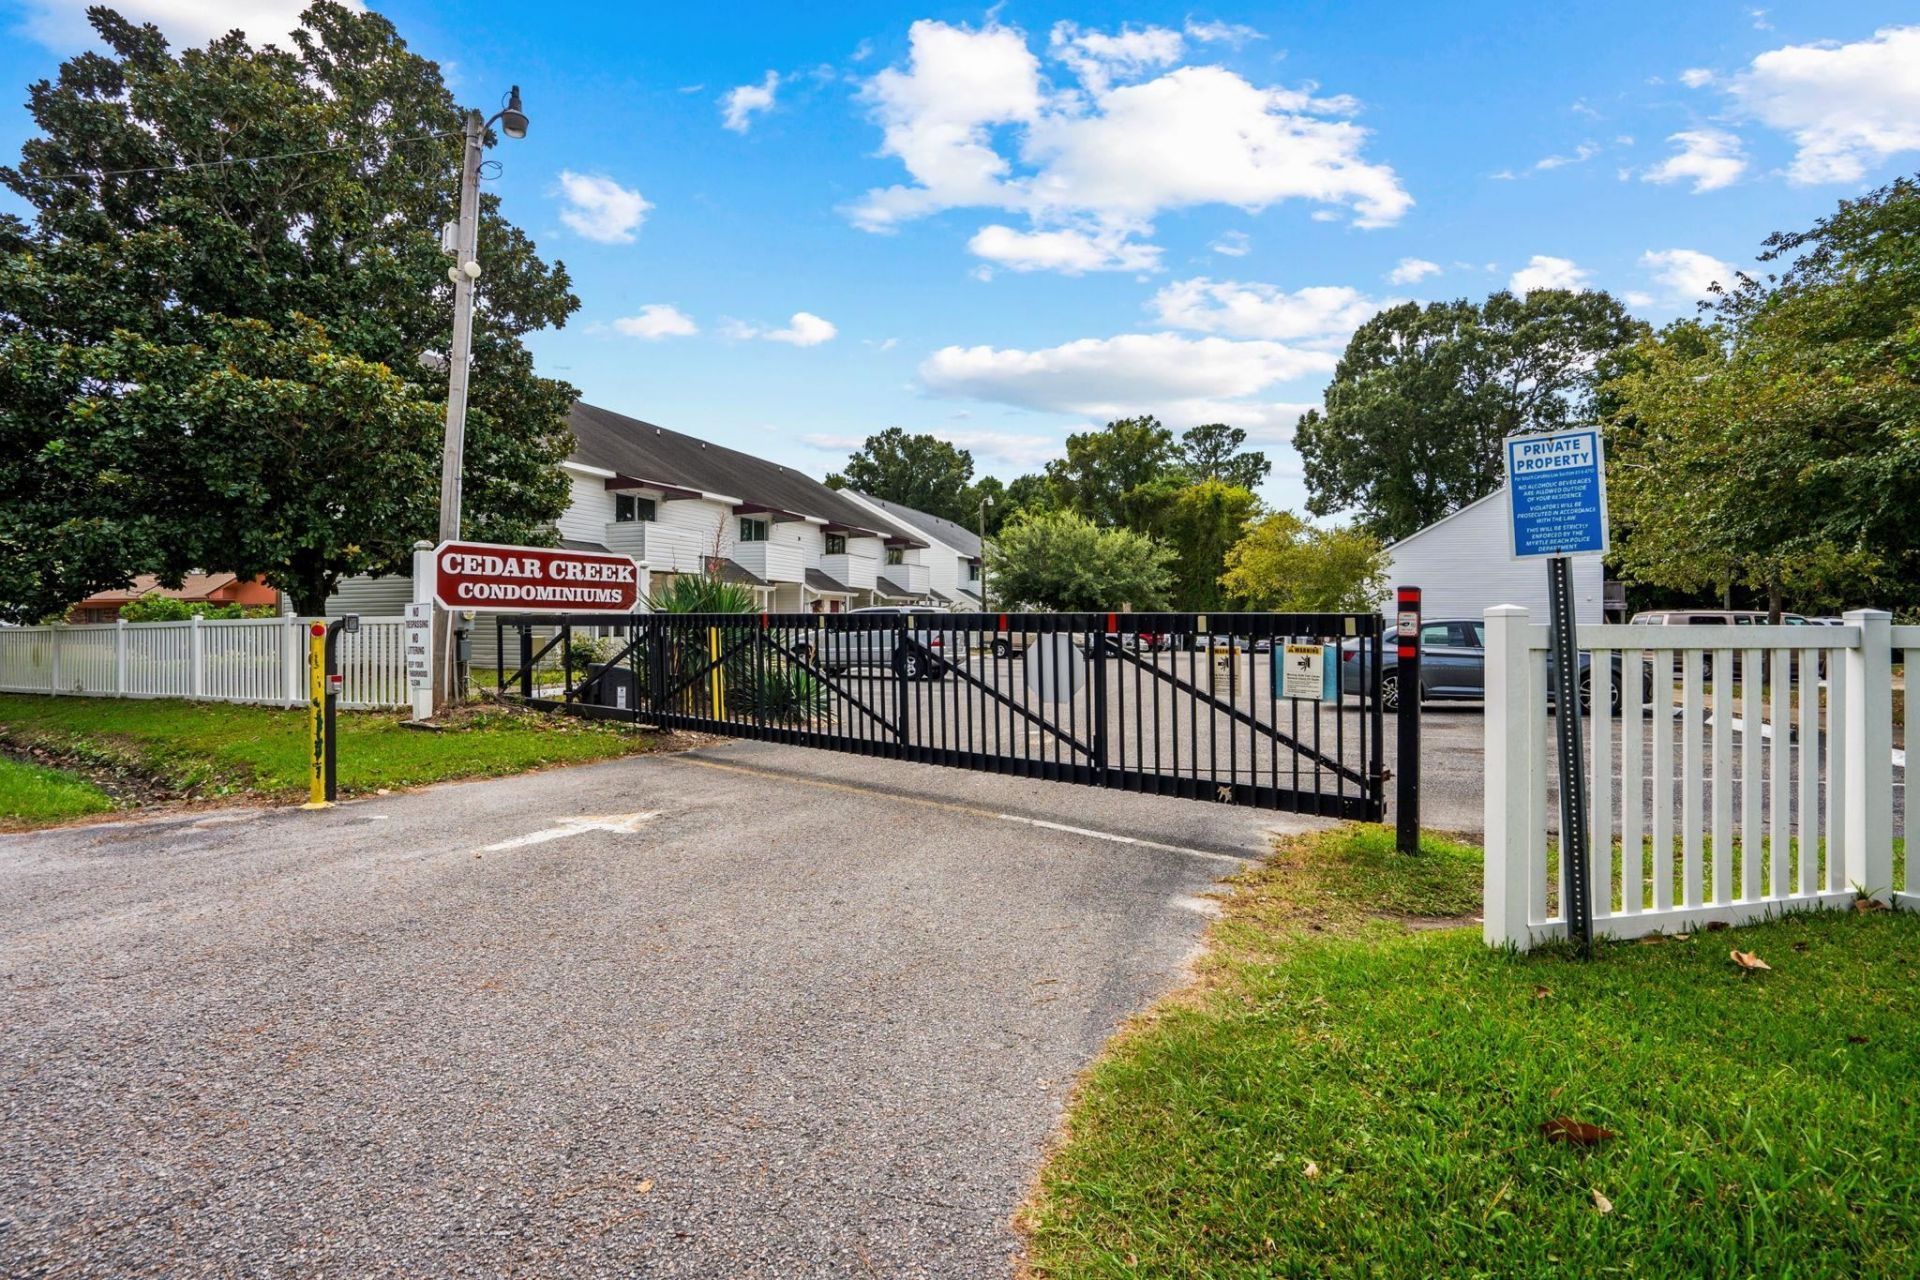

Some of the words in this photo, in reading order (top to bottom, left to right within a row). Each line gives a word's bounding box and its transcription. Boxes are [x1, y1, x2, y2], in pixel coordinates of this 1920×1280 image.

[1524, 439, 1580, 456] PRIVATE
[1517, 452, 1589, 471] PROPERTY
[1528, 481, 1558, 489] ALCOHOLIC
[1558, 478, 1592, 486] BEVERAGES
[1552, 492, 1582, 500] RESIDENCE
[1530, 503, 1560, 511] VIOLATORS
[1517, 510, 1552, 519] PROSECUTED
[1560, 506, 1596, 515] ACCORDANCE
[1538, 544, 1577, 552] DEPARTMENT
[441, 553, 543, 579] CEDAR
[549, 560, 635, 583] CREEK
[457, 582, 623, 604] CONDOMINIUMS
[413, 607, 419, 617] NO
[413, 633, 418, 643] NO
[1294, 646, 1319, 655] WARNING
